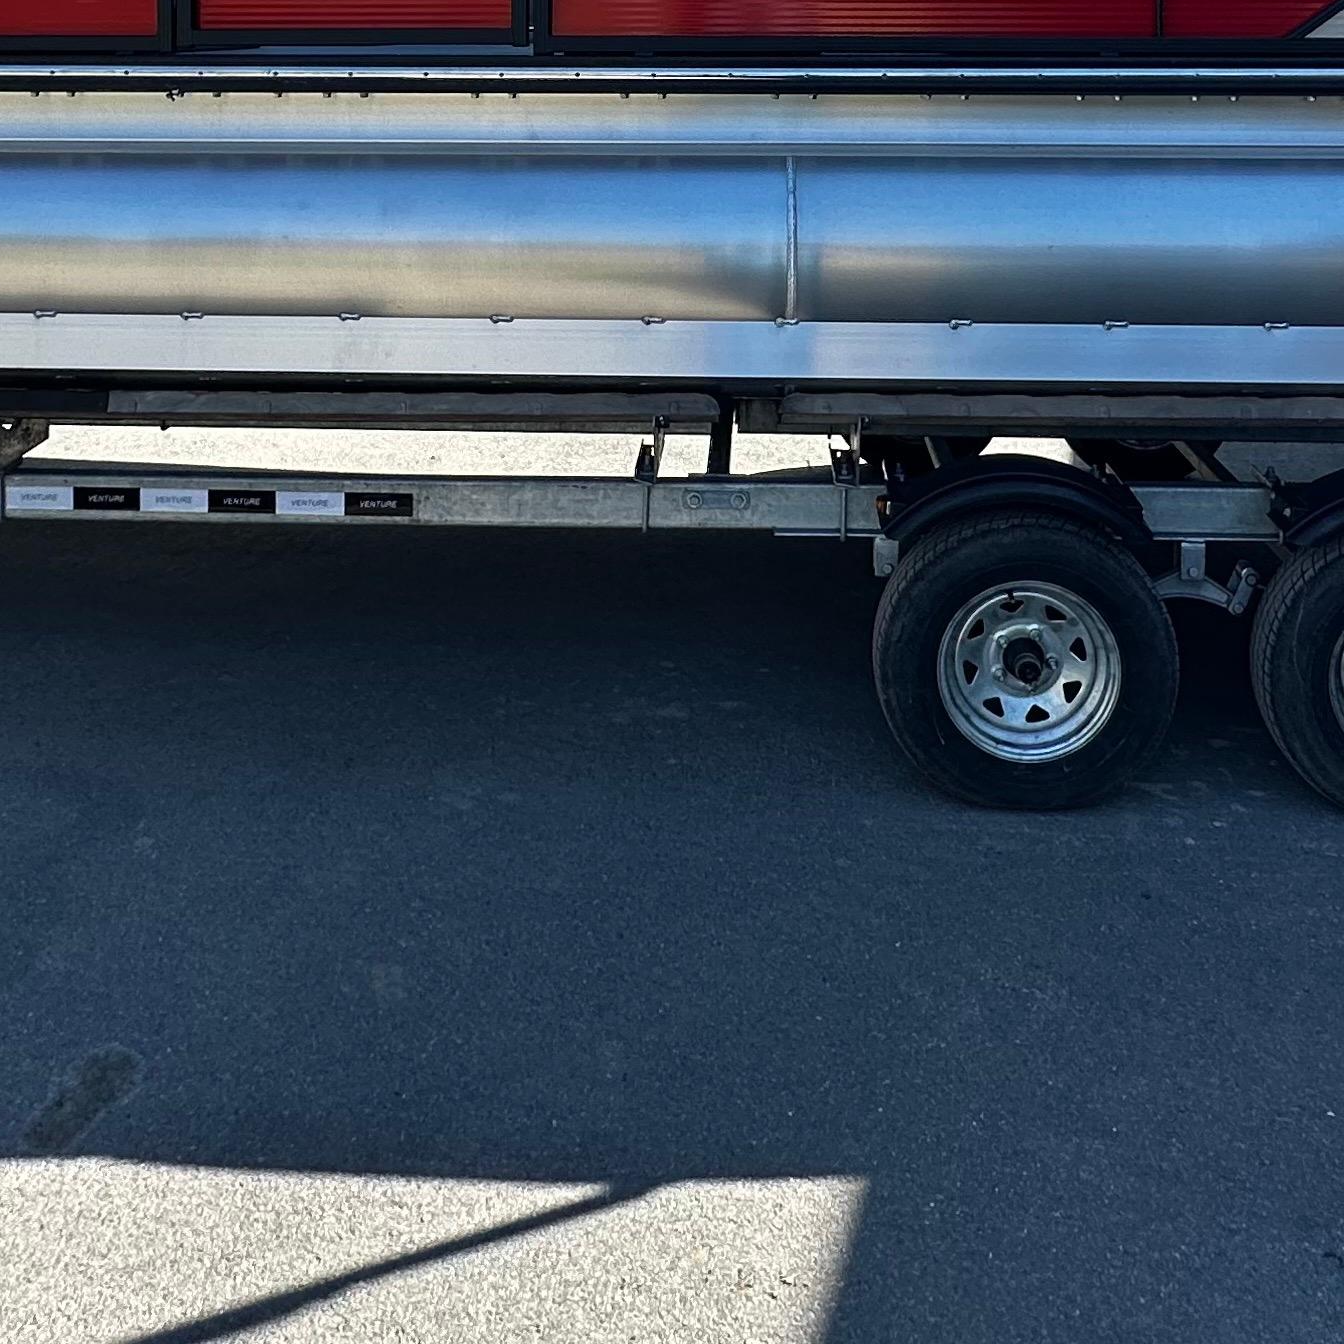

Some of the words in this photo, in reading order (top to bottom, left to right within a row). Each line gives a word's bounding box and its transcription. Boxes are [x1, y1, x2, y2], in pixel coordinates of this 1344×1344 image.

[87, 494, 125, 503] VENTURE
[155, 495, 192, 505] VENTURE
[222, 497, 261, 507] VENTURE
[291, 499, 329, 508] VENTURE
[359, 500, 397, 510] VENTURE
